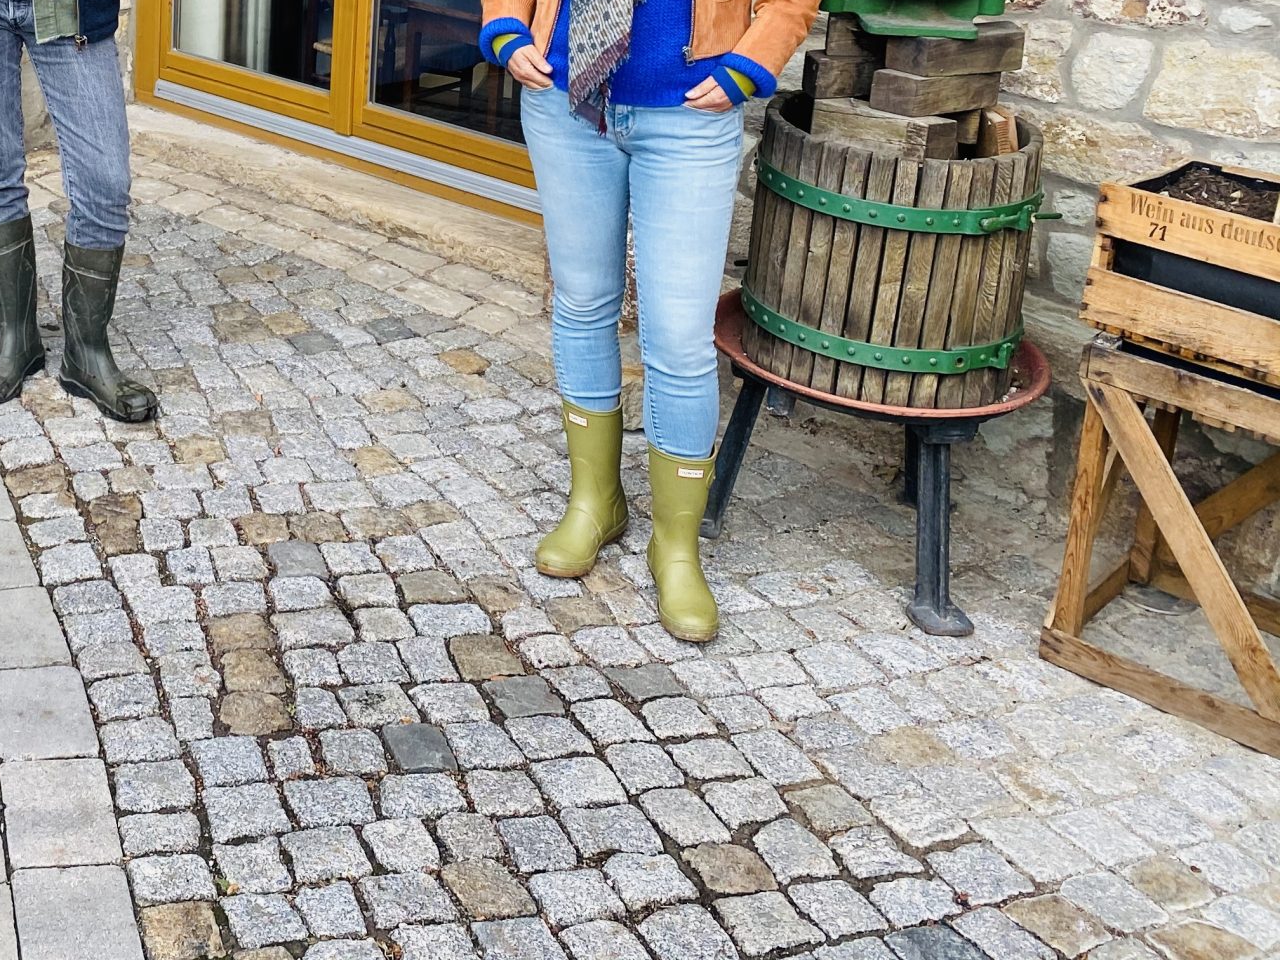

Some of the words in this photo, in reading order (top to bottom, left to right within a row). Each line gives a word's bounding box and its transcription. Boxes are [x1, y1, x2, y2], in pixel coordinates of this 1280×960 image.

[1130, 192, 1174, 224] Wein
[1180, 212, 1215, 235] aus
[1148, 222, 1168, 242] 71
